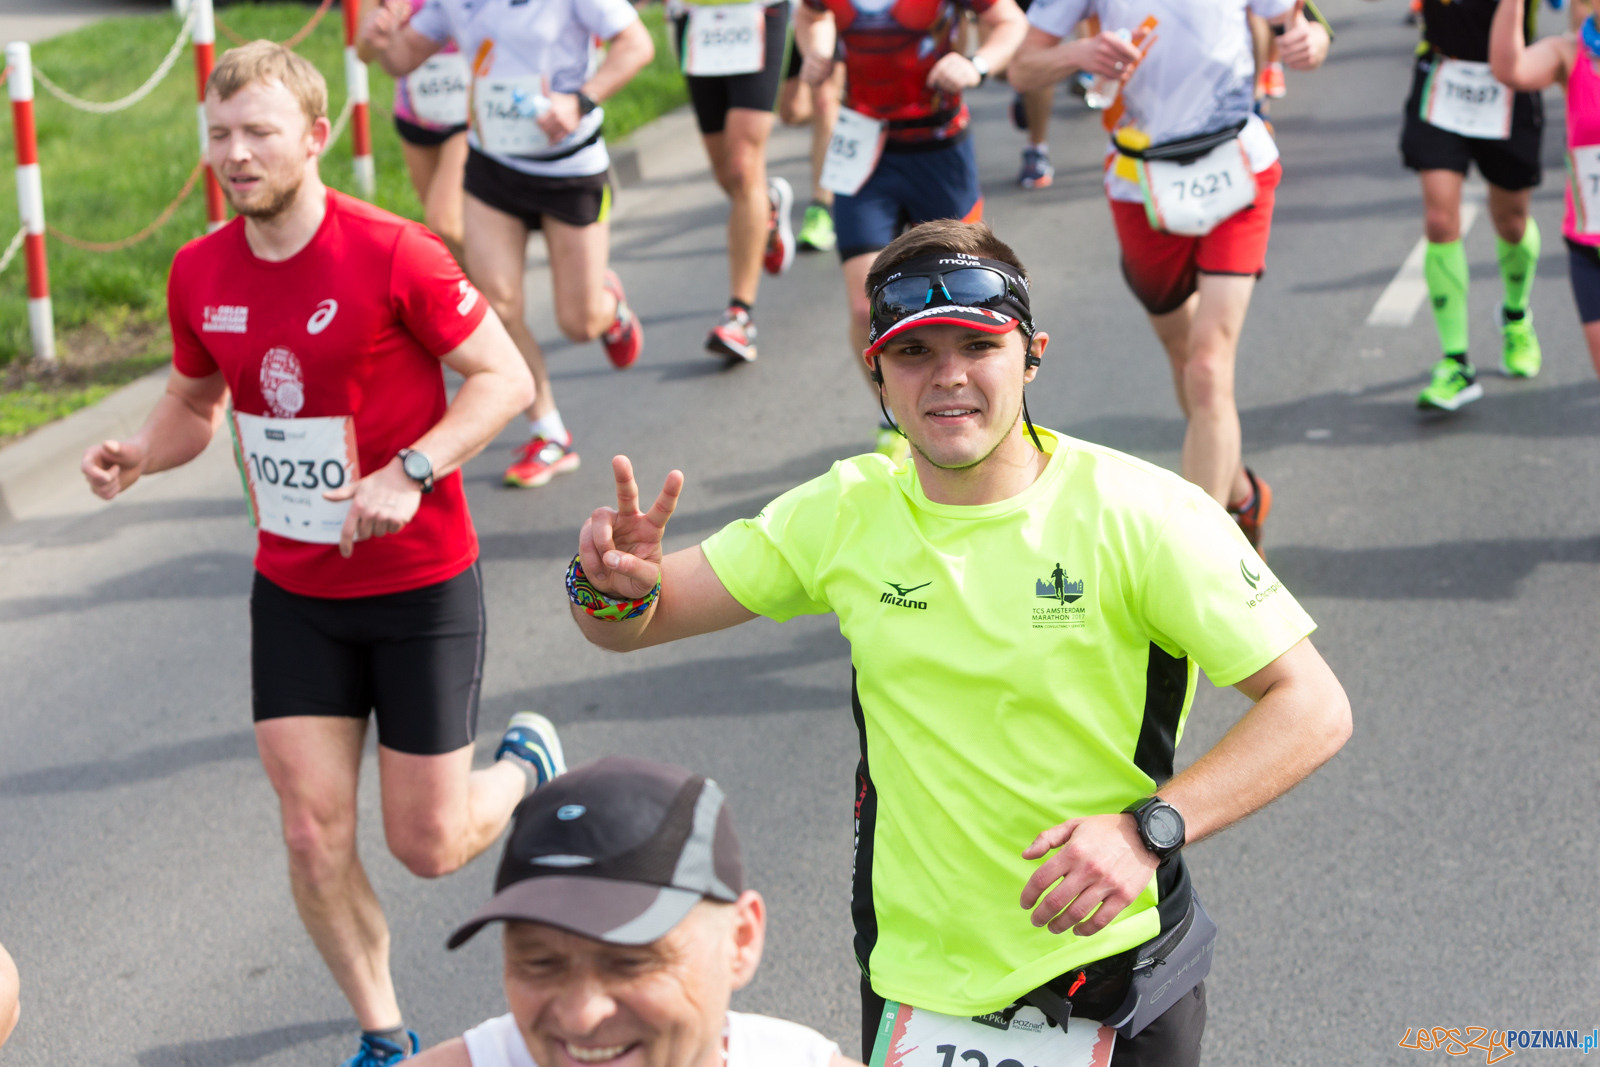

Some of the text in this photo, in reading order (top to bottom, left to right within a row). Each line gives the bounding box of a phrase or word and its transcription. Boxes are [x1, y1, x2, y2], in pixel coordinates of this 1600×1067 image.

[1171, 170, 1232, 201] 7621
[939, 258, 981, 267] move
[250, 452, 345, 490] 10230
